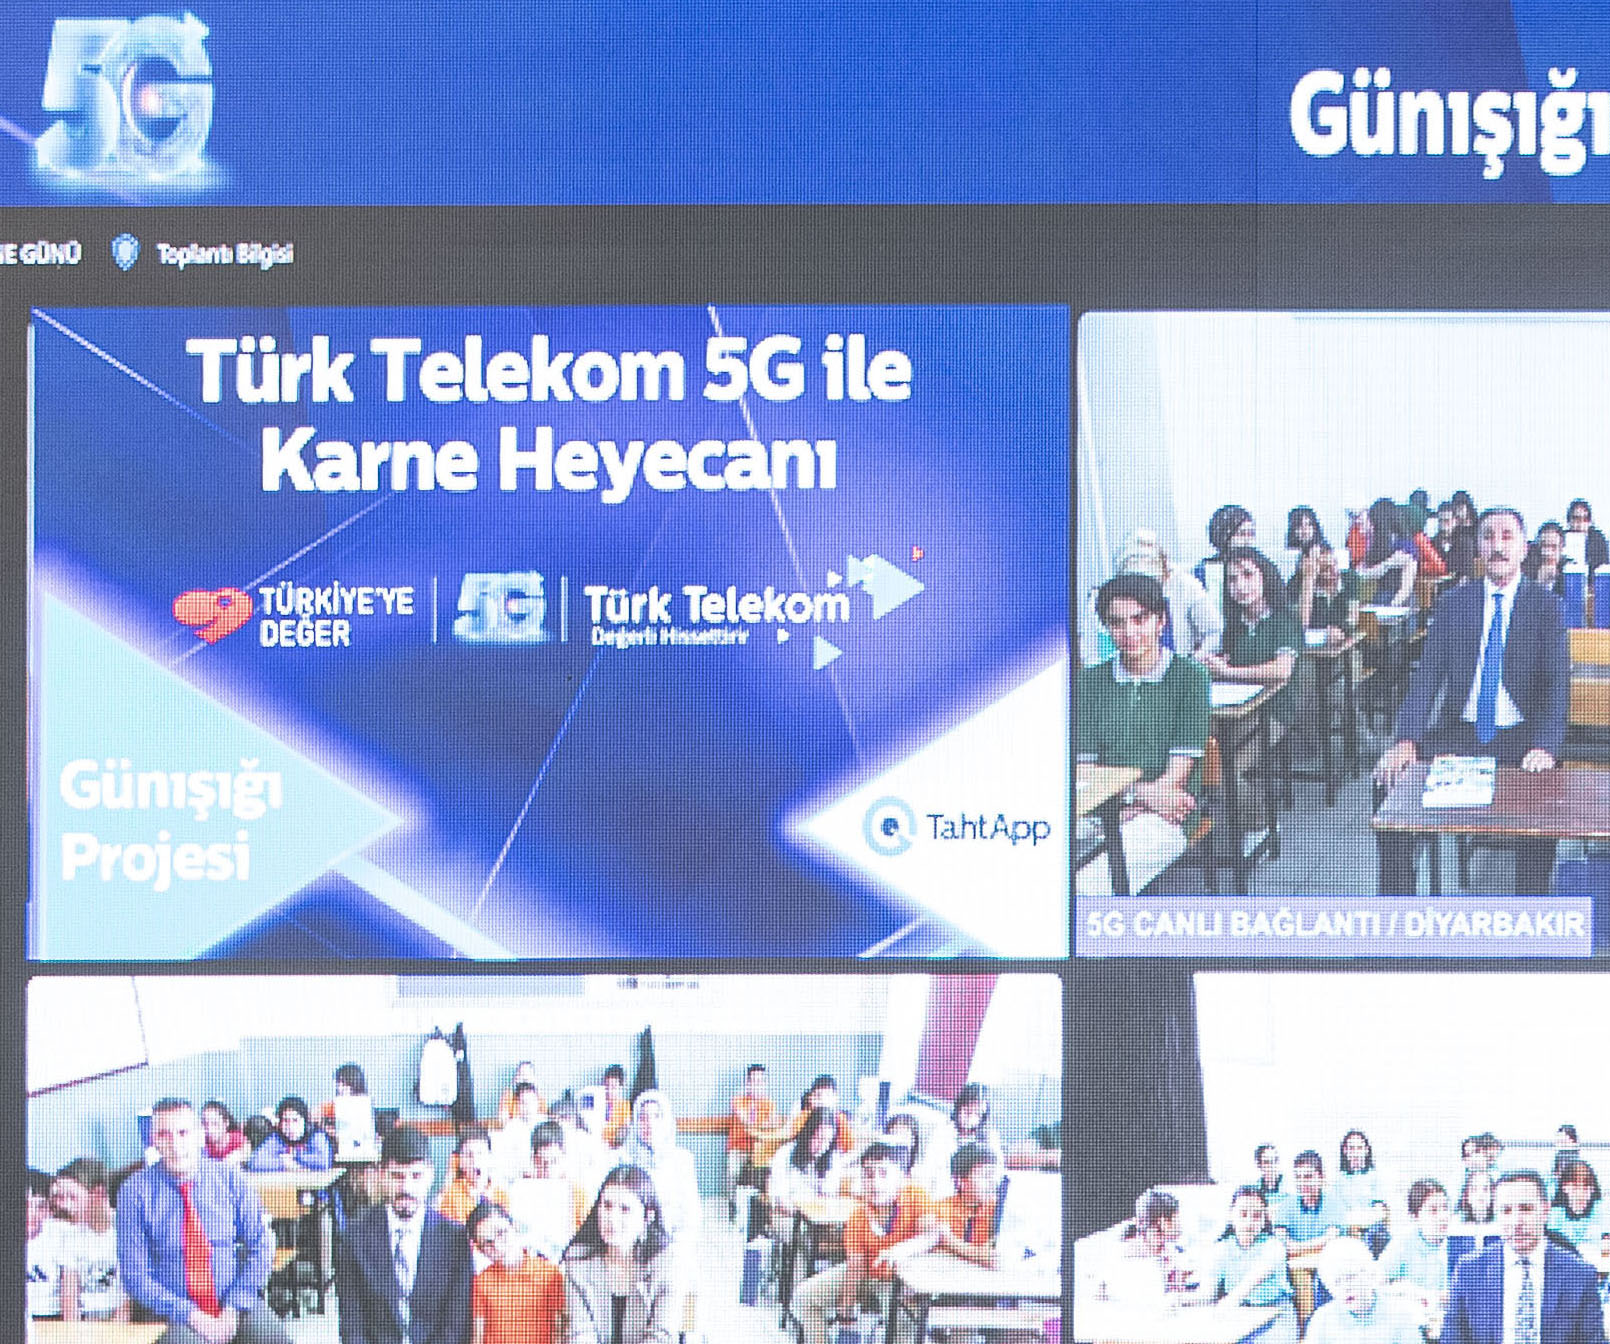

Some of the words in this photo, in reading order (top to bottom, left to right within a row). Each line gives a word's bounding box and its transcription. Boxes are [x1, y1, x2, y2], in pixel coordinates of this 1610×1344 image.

[35, 13, 213, 180] 5G
[19, 240, 82, 264] GÜNÜ
[186, 336, 356, 402] Türk
[370, 335, 685, 402] Telekom
[703, 335, 805, 401] 5G
[822, 335, 913, 402] ile
[261, 426, 479, 491] Karne
[499, 426, 838, 504] Heyecanı
[259, 581, 414, 615] TÜRKİYE'YE
[452, 570, 546, 645] 5G
[584, 585, 672, 624] Türk
[682, 585, 850, 624] Telekom
[260, 614, 351, 647] DEĞER
[60, 757, 283, 821] Günışığı
[926, 813, 1051, 847] TahtApp
[61, 830, 250, 893] Projesi
[1086, 911, 1125, 937] 5G
[1133, 911, 1223, 937] CANLI
[1230, 906, 1382, 937] BAĞLANTI
[1405, 906, 1586, 937] DİYARBAKIR
